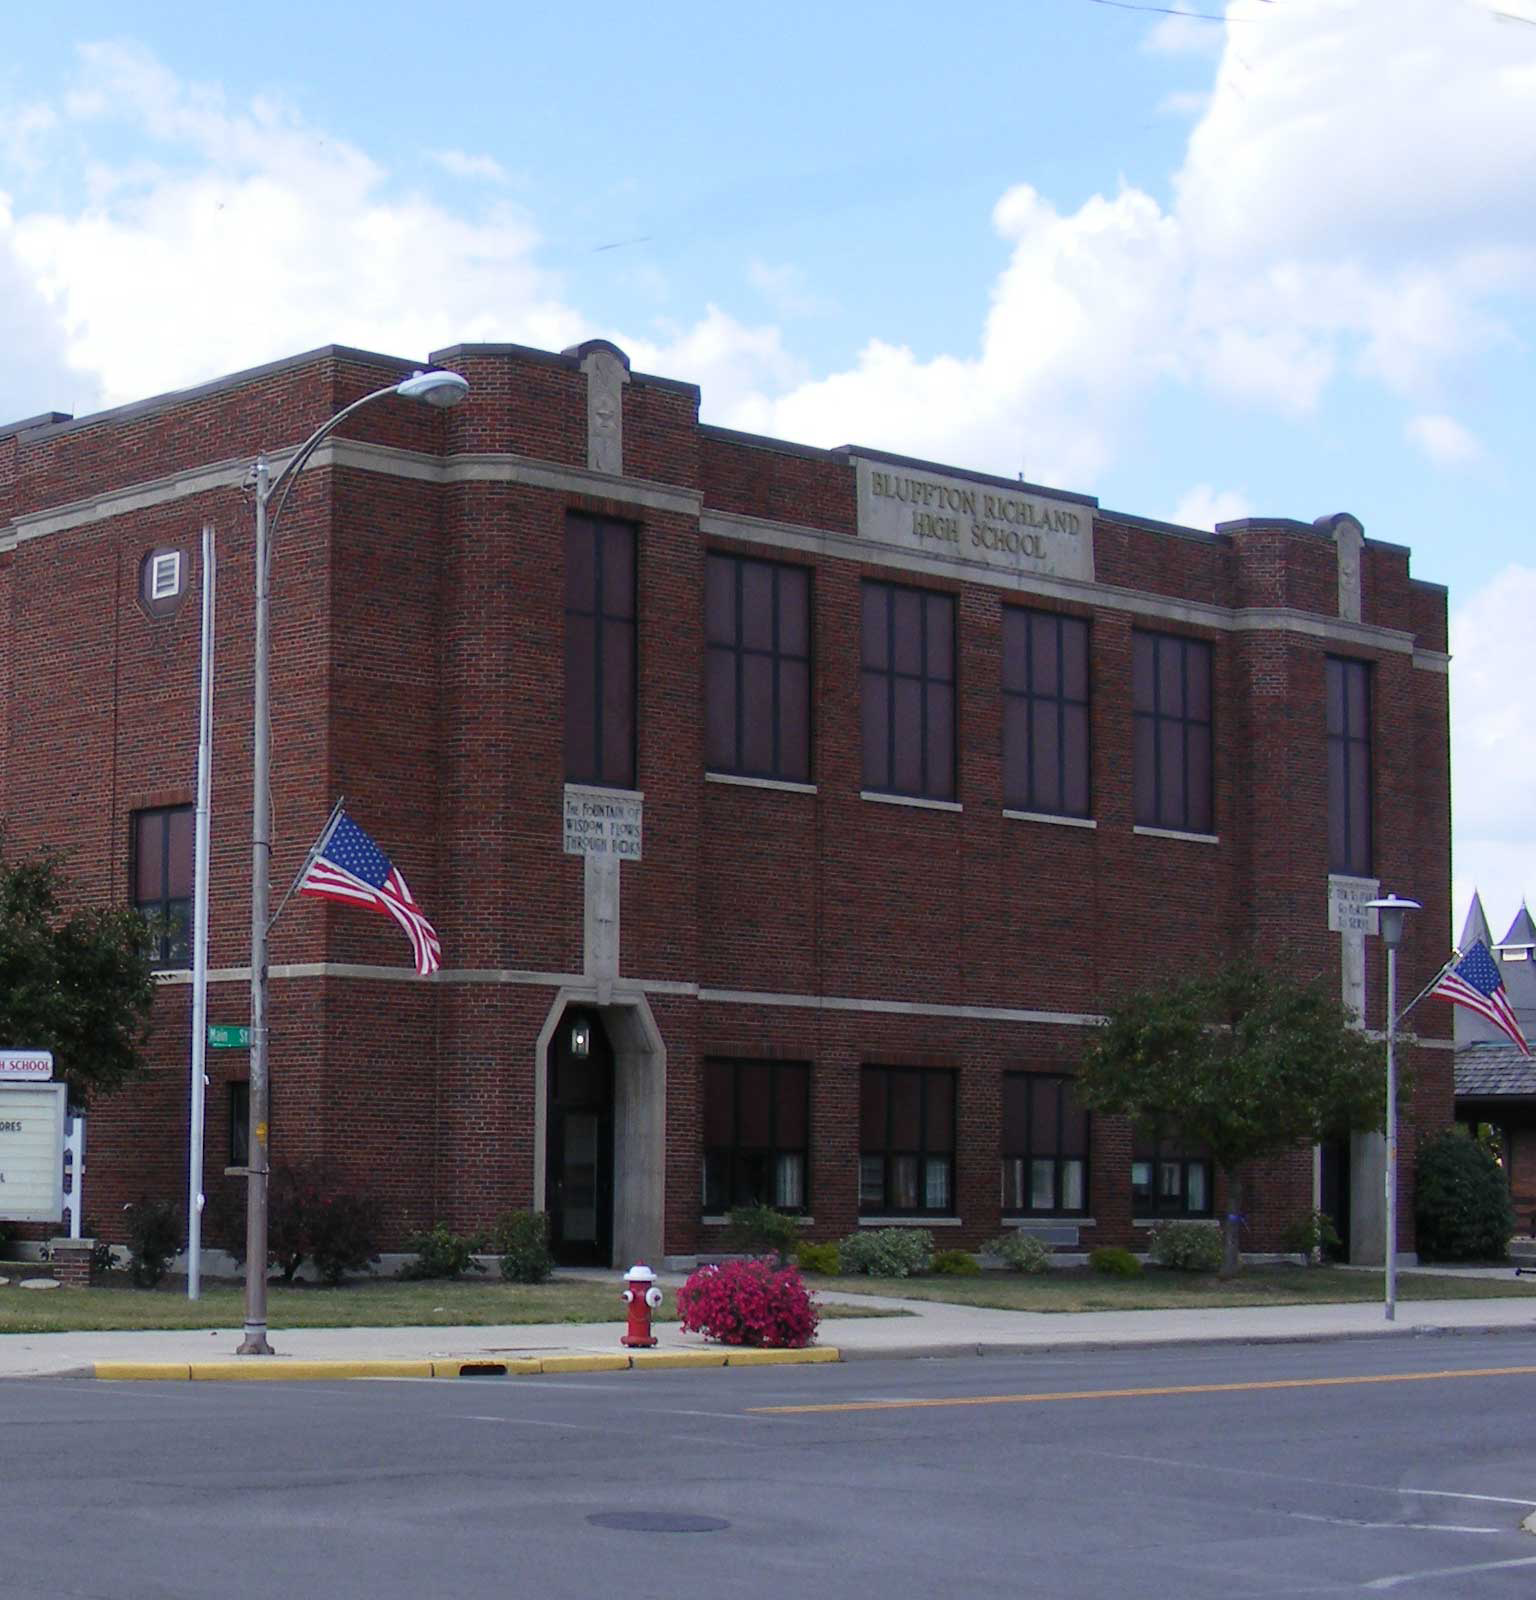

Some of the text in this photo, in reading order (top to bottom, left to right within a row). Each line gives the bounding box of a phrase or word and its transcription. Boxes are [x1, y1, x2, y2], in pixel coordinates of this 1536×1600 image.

[872, 471, 1079, 535] BLUFFTON RICHLAND
[912, 511, 1047, 560] HIGH SCHOOL
[566, 819, 640, 837] WISDOM FLOWS
[209, 1028, 228, 1042] Main
[9, 1060, 50, 1071] SCHOOL
